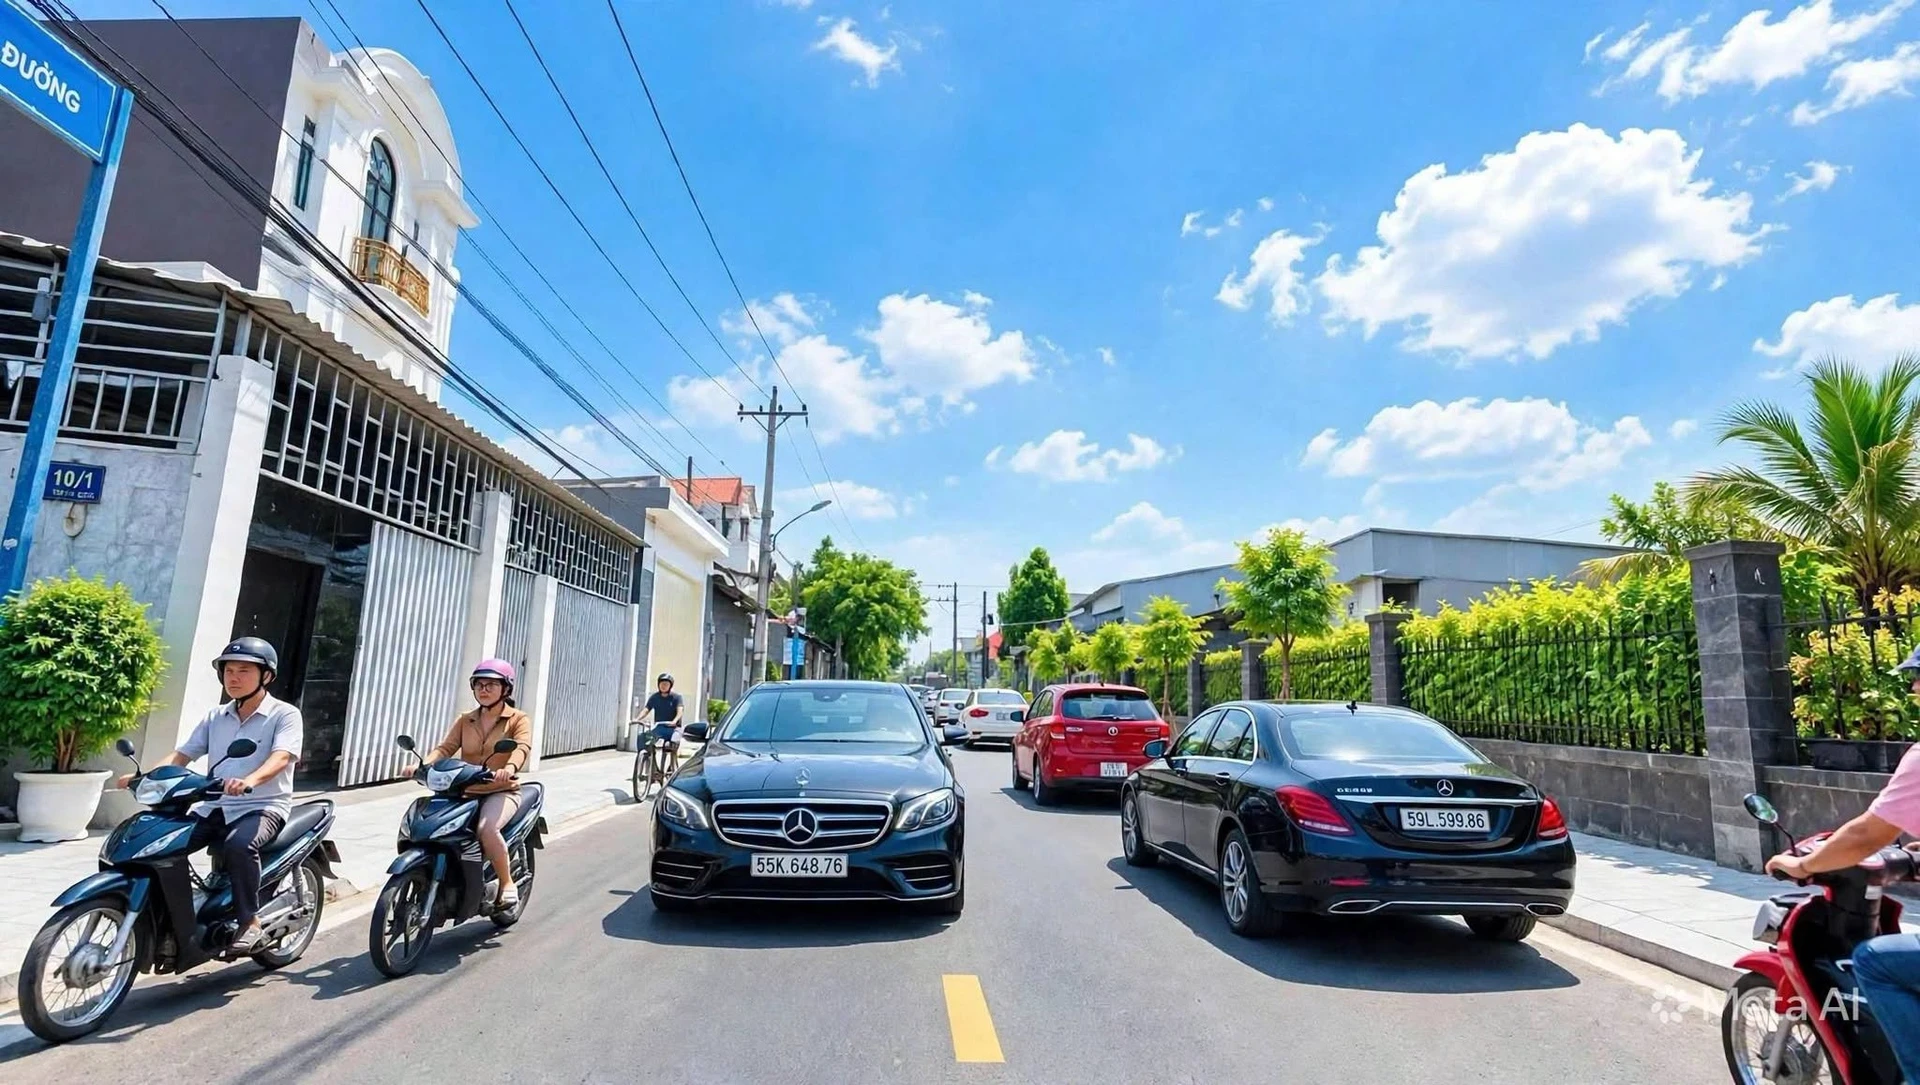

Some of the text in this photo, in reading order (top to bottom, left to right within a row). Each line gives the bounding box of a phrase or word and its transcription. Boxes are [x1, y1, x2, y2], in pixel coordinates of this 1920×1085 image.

[53, 469, 93, 489] 10/1
[1408, 811, 1486, 828] 59L.599.86
[756, 857, 843, 875] 55K.648.76
